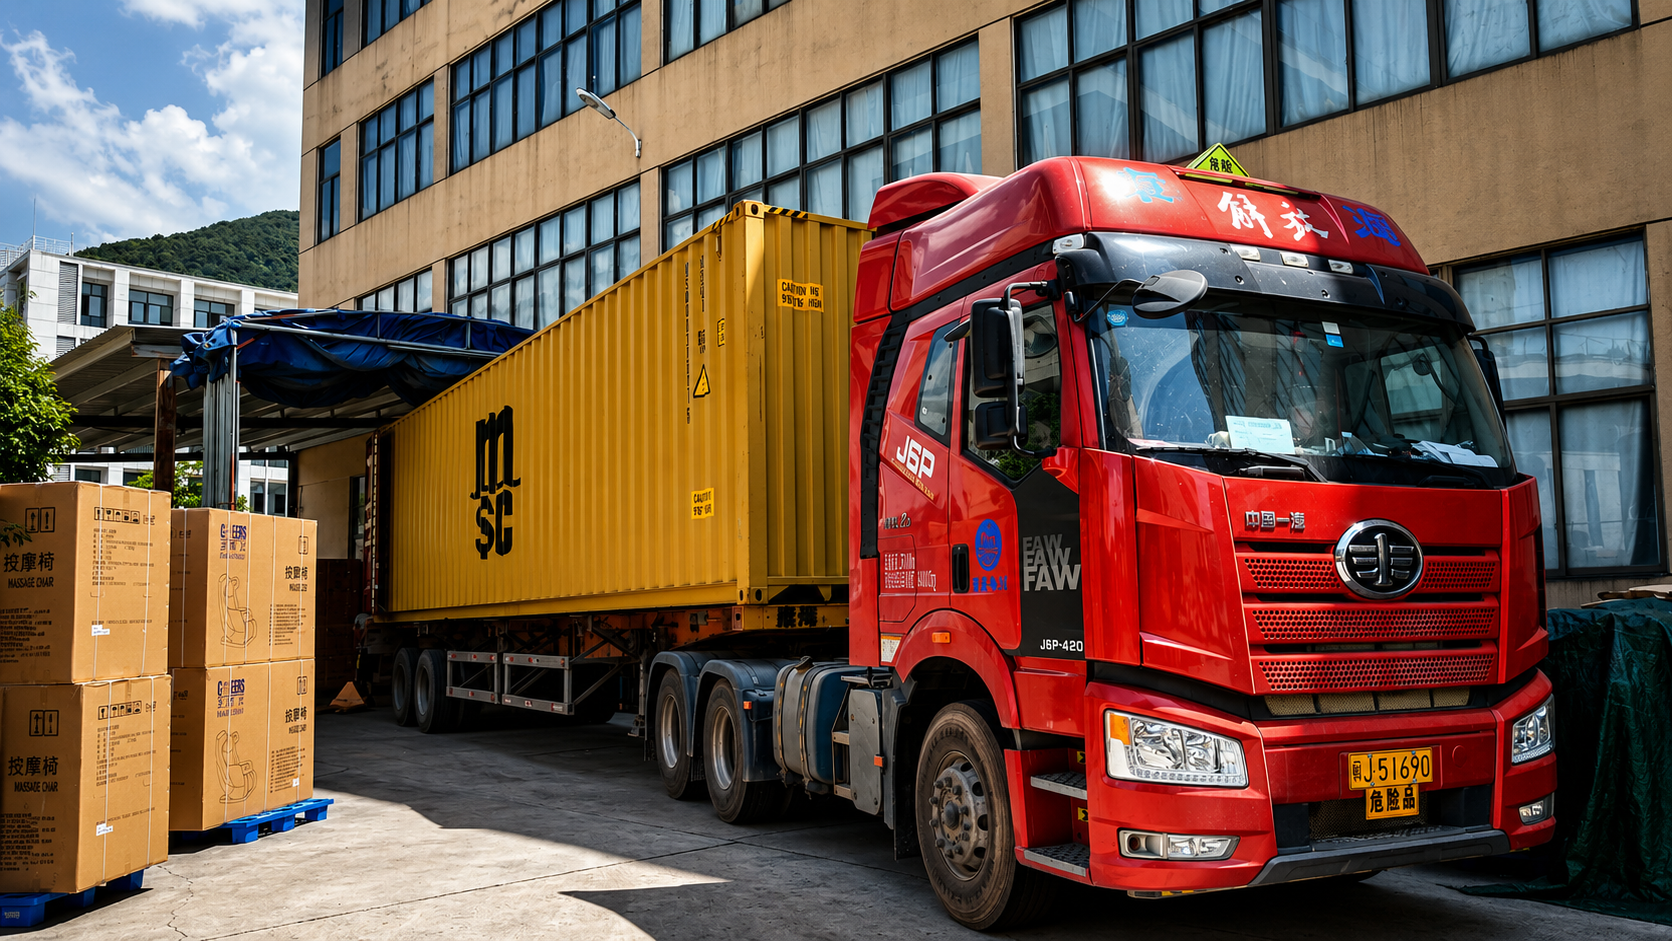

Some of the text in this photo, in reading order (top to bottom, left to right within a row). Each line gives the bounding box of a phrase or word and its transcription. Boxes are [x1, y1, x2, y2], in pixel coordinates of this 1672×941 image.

[896, 435, 935, 479] J6P
[1024, 564, 1081, 592] FAW
[1040, 639, 1083, 652] J6P-420
[1370, 786, 1415, 813] 危险品
